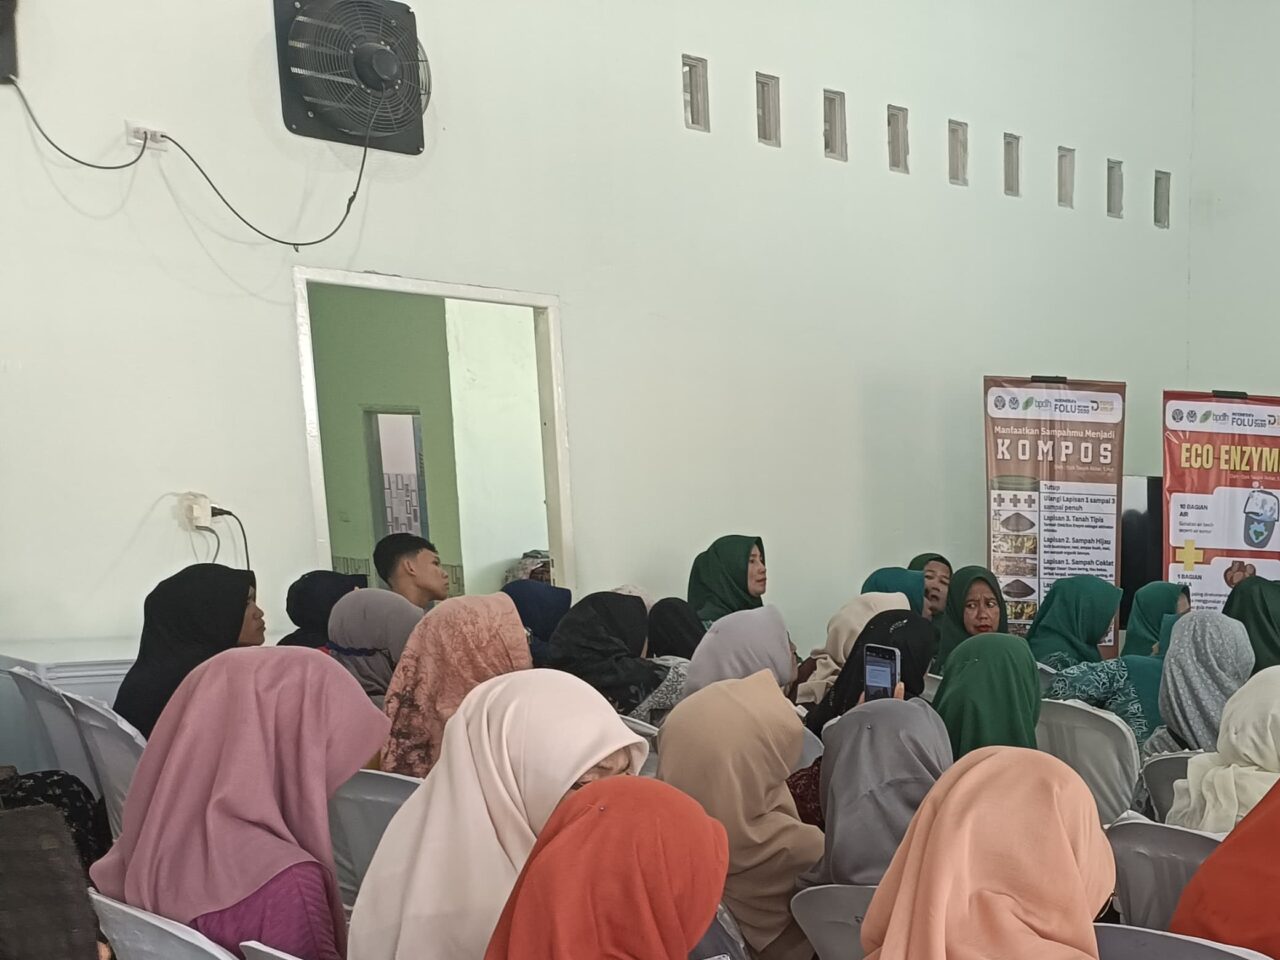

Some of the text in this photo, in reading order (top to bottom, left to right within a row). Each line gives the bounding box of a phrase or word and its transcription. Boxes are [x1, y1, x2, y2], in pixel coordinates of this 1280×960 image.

[1054, 403, 1077, 414] FOLU
[1231, 417, 1254, 427] FOLU
[994, 425, 1115, 440] Manfaatkan Sampahmu Menjadi
[996, 438, 1112, 464] KOMPOS
[1180, 442, 1214, 469] ECO
